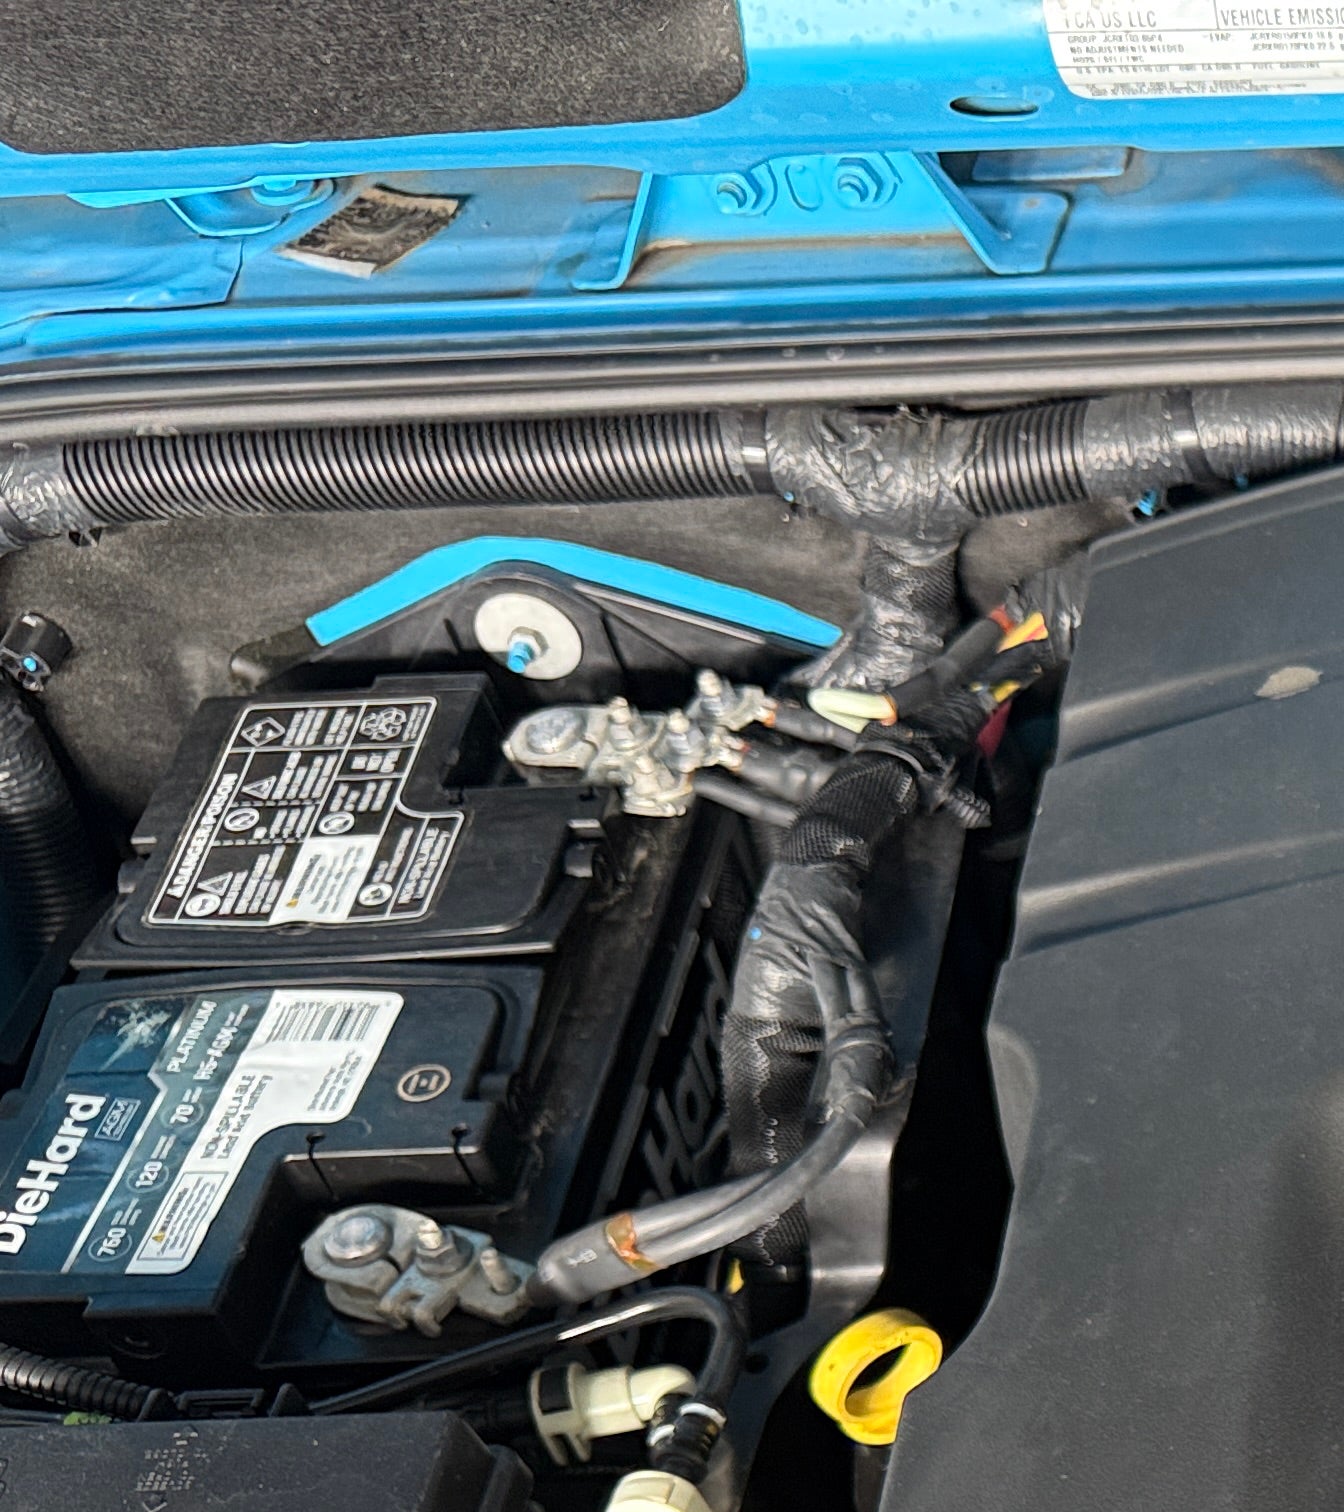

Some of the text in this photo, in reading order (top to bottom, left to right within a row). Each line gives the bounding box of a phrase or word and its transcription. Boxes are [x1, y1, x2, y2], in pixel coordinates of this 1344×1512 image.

[1101, 11, 1122, 28] US
[1128, 11, 1156, 28] LLC
[1221, 9, 1283, 26] VEHICLE
[166, 1001, 217, 1072] PLATINUM
[170, 1104, 194, 1124] 70
[0, 1093, 106, 1254] DieHard
[136, 1161, 162, 1188] 120
[97, 1228, 126, 1257] 760
